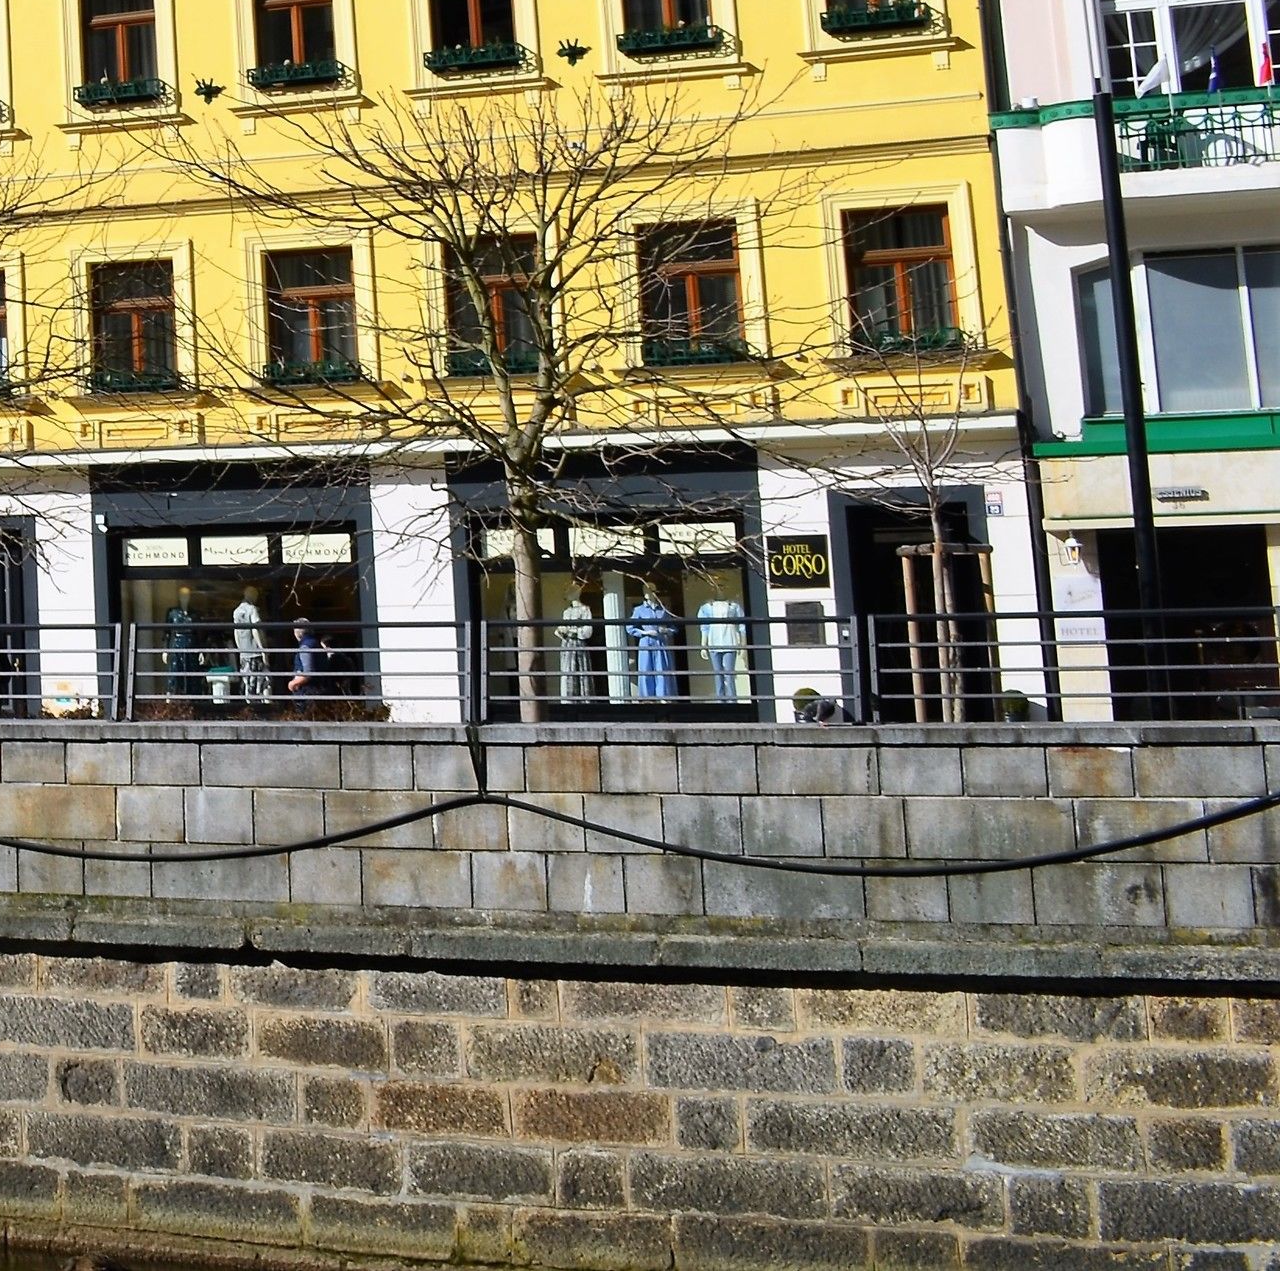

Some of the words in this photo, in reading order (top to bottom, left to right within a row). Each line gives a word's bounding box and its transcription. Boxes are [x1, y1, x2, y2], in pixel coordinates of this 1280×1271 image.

[286, 548, 348, 557] RICHMOND
[782, 544, 811, 554] HOTEL
[125, 551, 185, 560] RICHMOND
[770, 554, 826, 579] CORSO
